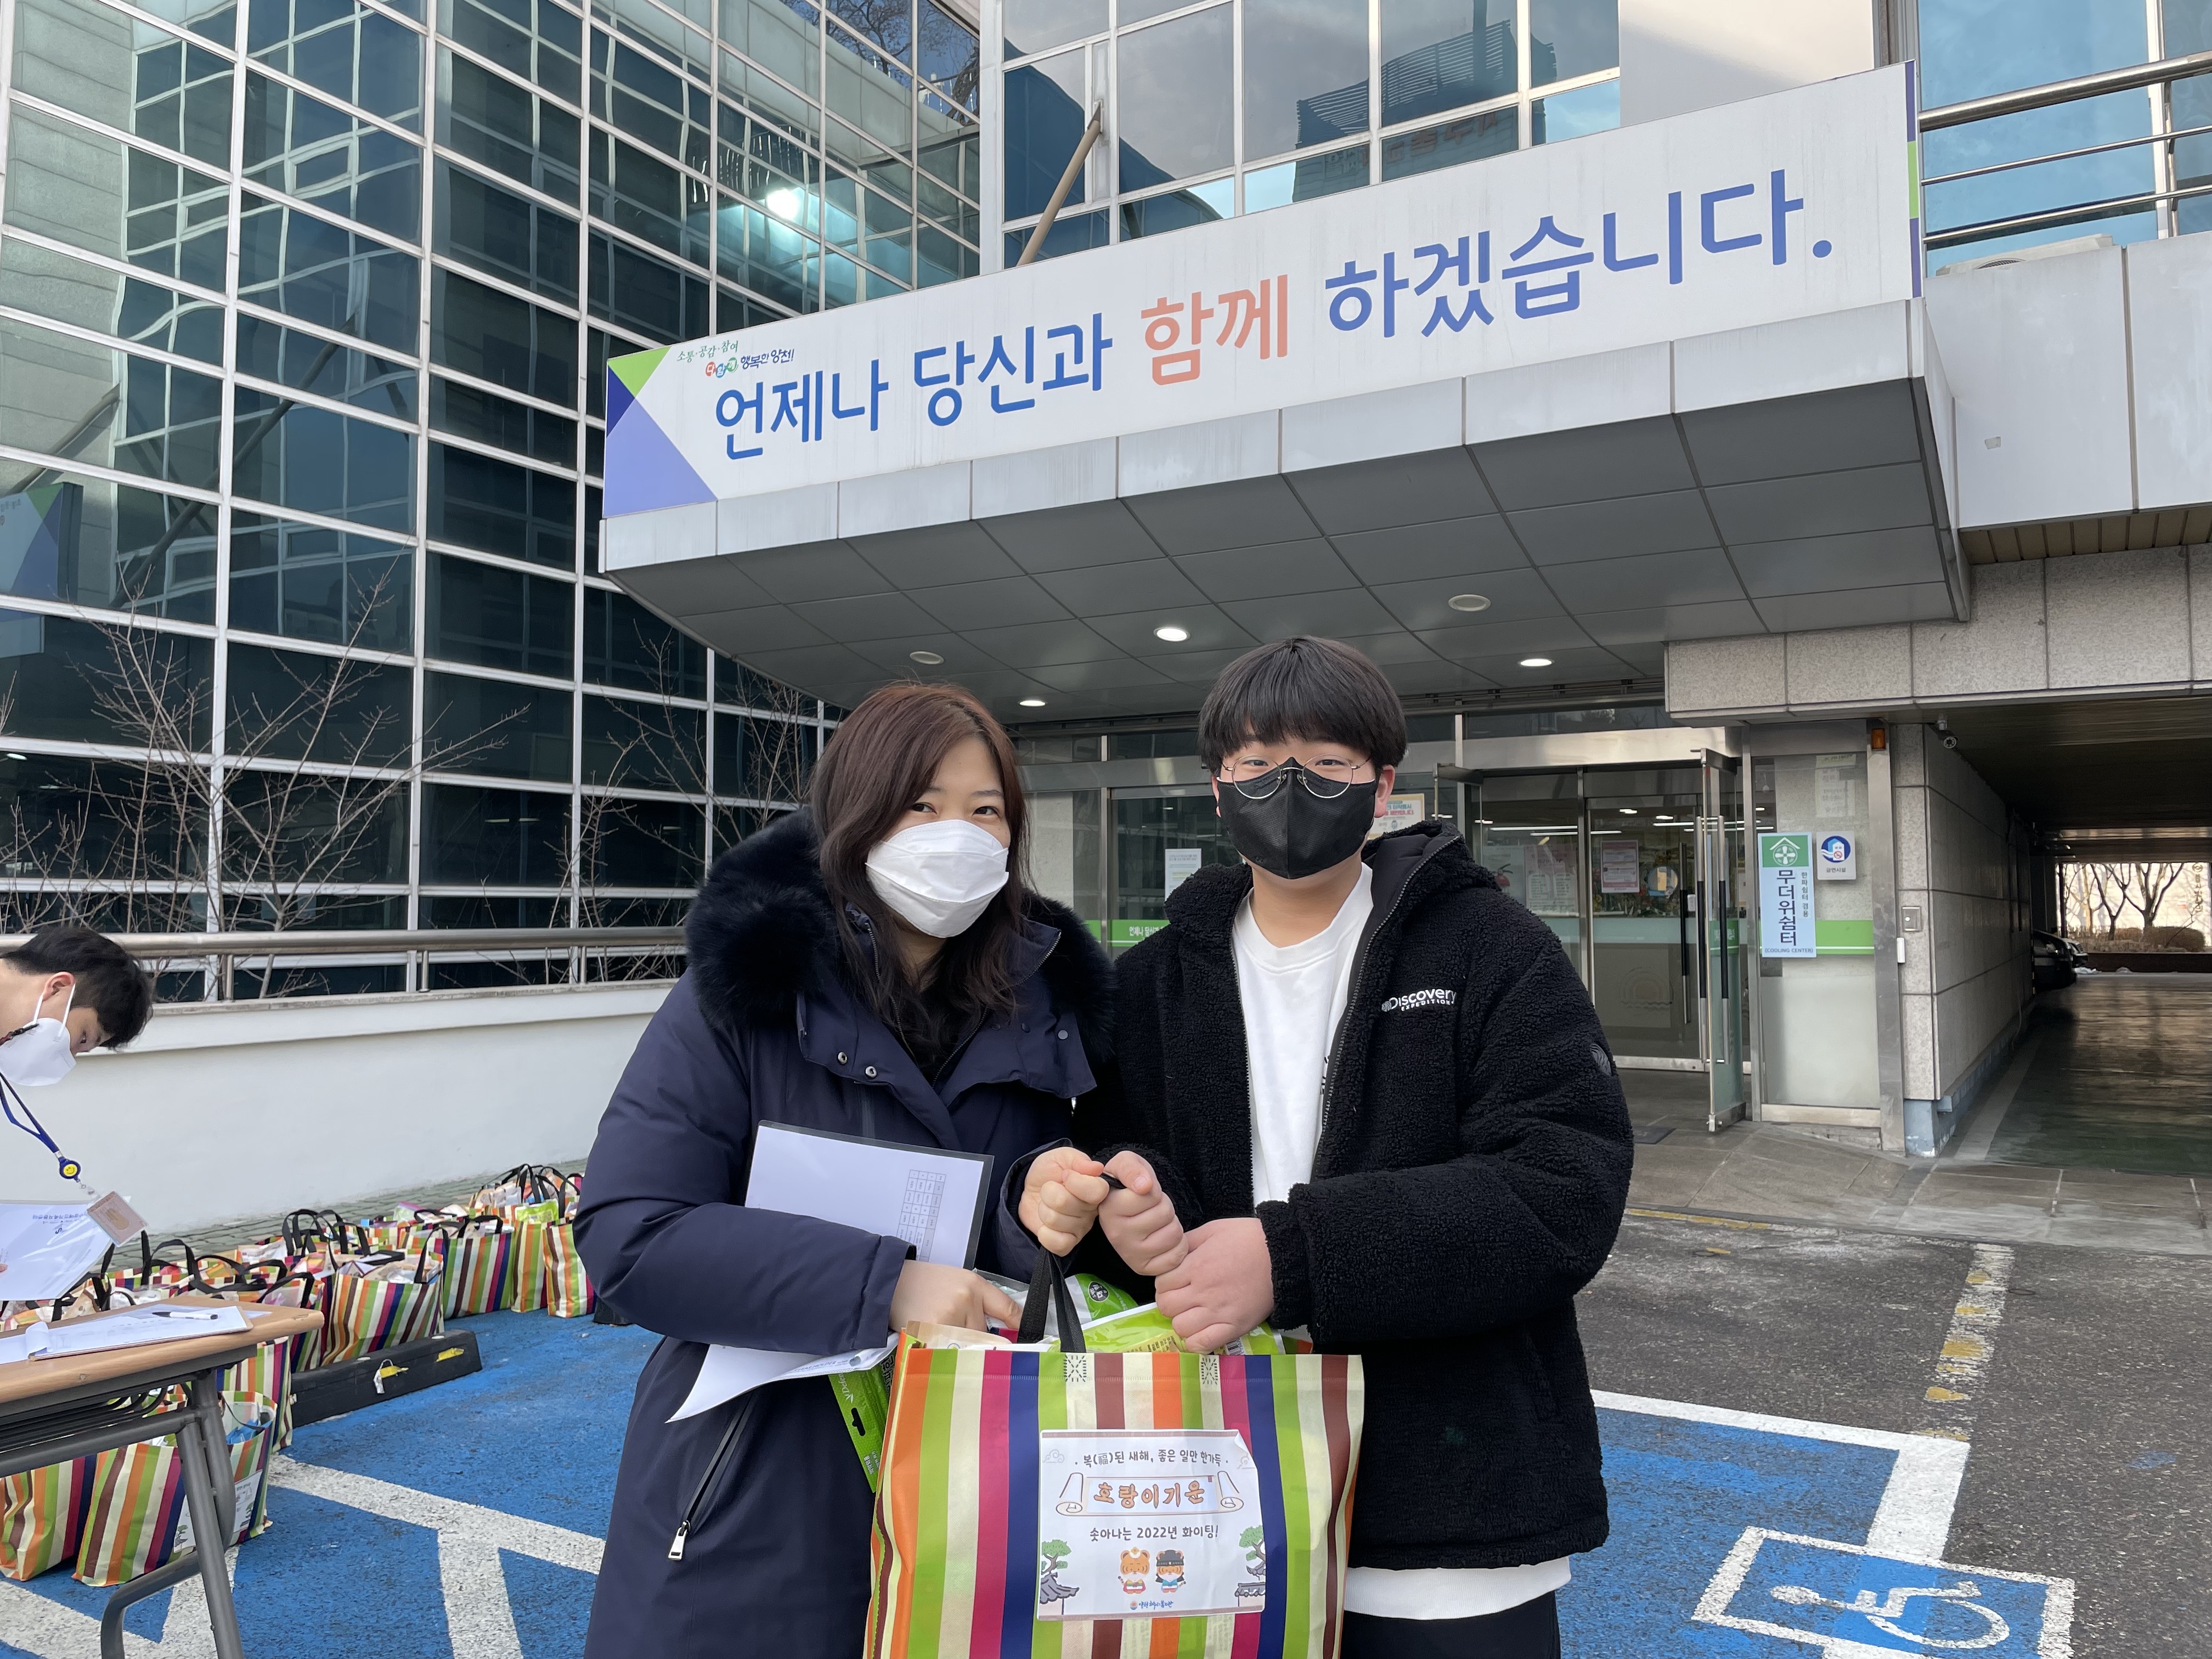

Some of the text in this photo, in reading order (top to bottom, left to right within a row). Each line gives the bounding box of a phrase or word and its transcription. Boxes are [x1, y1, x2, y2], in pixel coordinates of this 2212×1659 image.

[716, 169, 1832, 460] 언제나 당신과 함께 하겠습니다.
[741, 353, 769, 370] 행복한
[770, 348, 795, 364] 양천!
[1776, 870, 1797, 946] 무더위쉼터
[1401, 999, 1451, 1012] EXPEDITION
[1128, 1450, 1154, 1463] 새해,
[1158, 1449, 1176, 1463] 좋은
[1180, 1449, 1198, 1463] 일만
[1200, 1451, 1222, 1467] 한가득
[1093, 1480, 1205, 1509] 호랑이기운
[1090, 1525, 1218, 1542] 솟아나는 2022년 화이팅!
